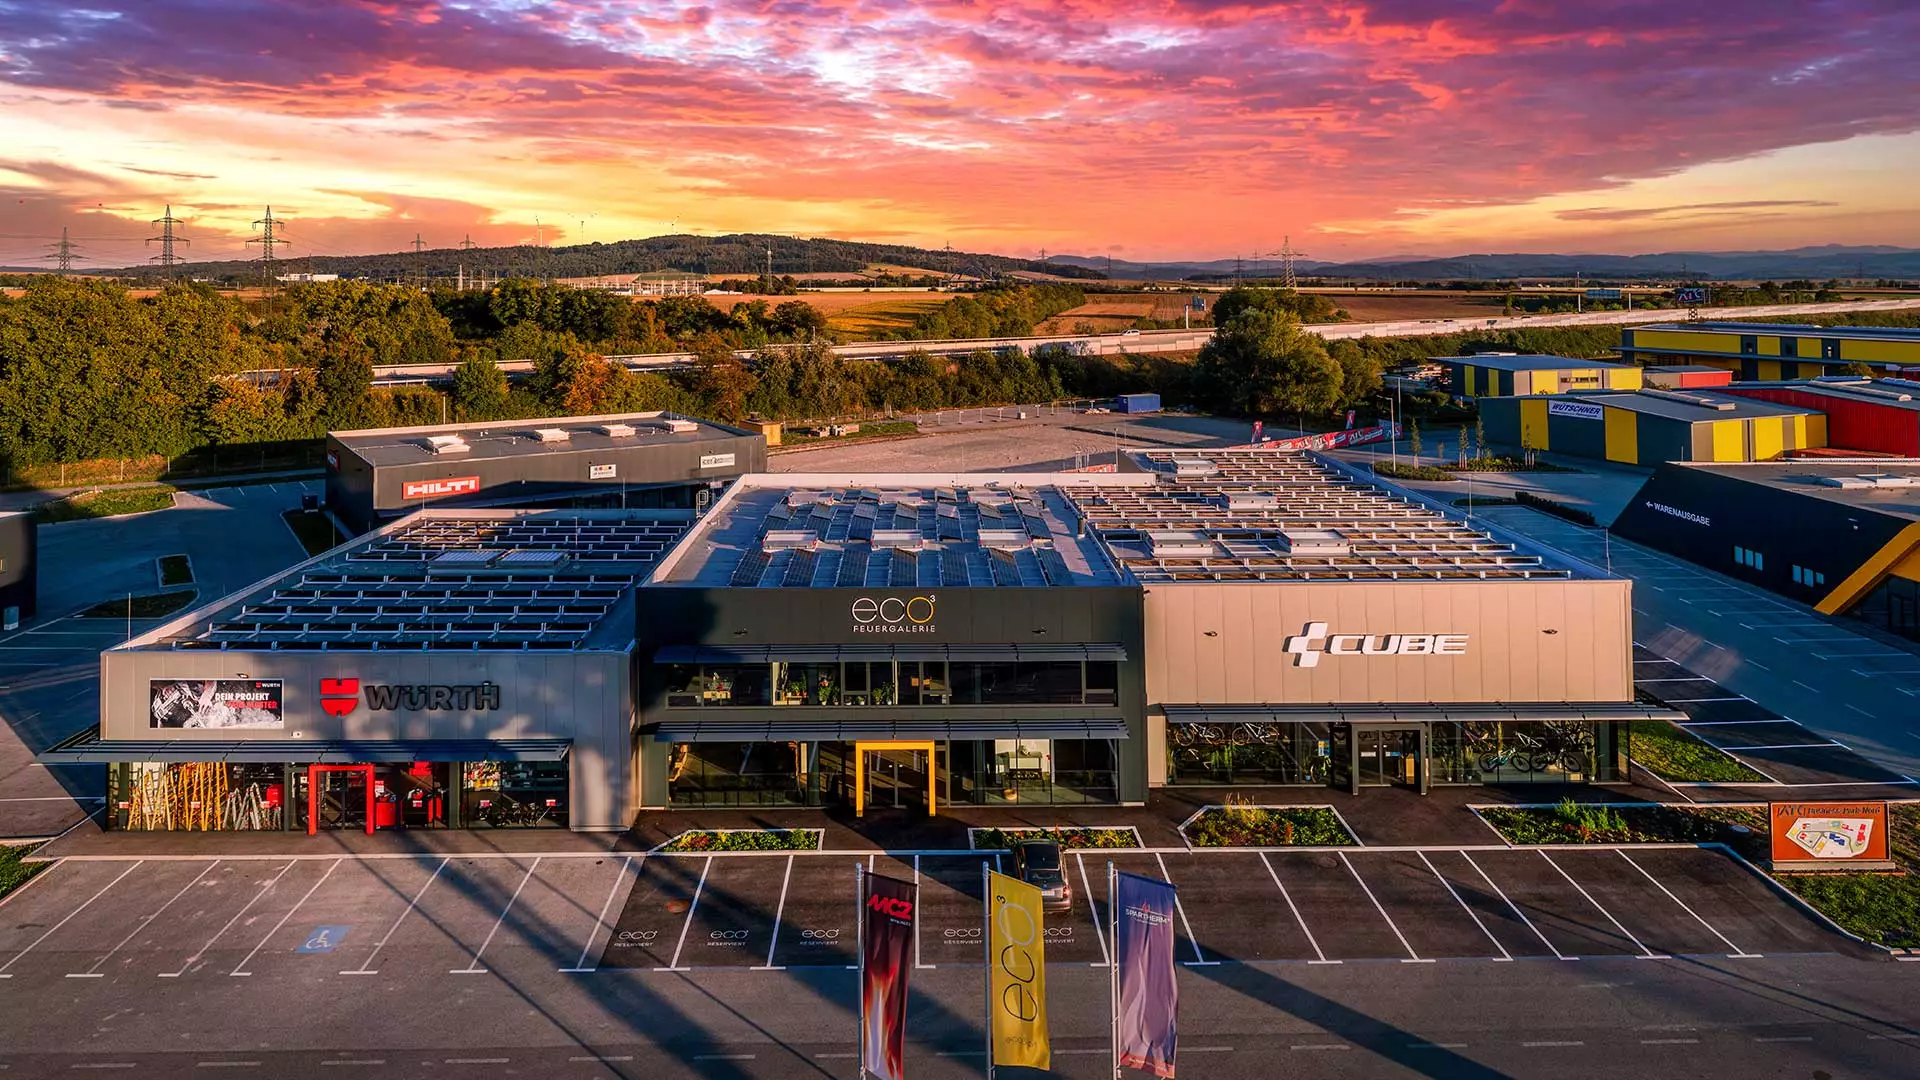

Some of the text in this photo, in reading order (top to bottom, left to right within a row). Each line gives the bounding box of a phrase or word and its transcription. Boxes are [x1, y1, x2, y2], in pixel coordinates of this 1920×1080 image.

[407, 479, 475, 496] HILTI
[1653, 502, 1711, 527] WARENAUSGABE
[853, 625, 936, 633] FEUERGALERIE
[1328, 633, 1469, 655] CUBE
[235, 692, 270, 701] PROJEKT
[363, 684, 501, 711] WÜRTH
